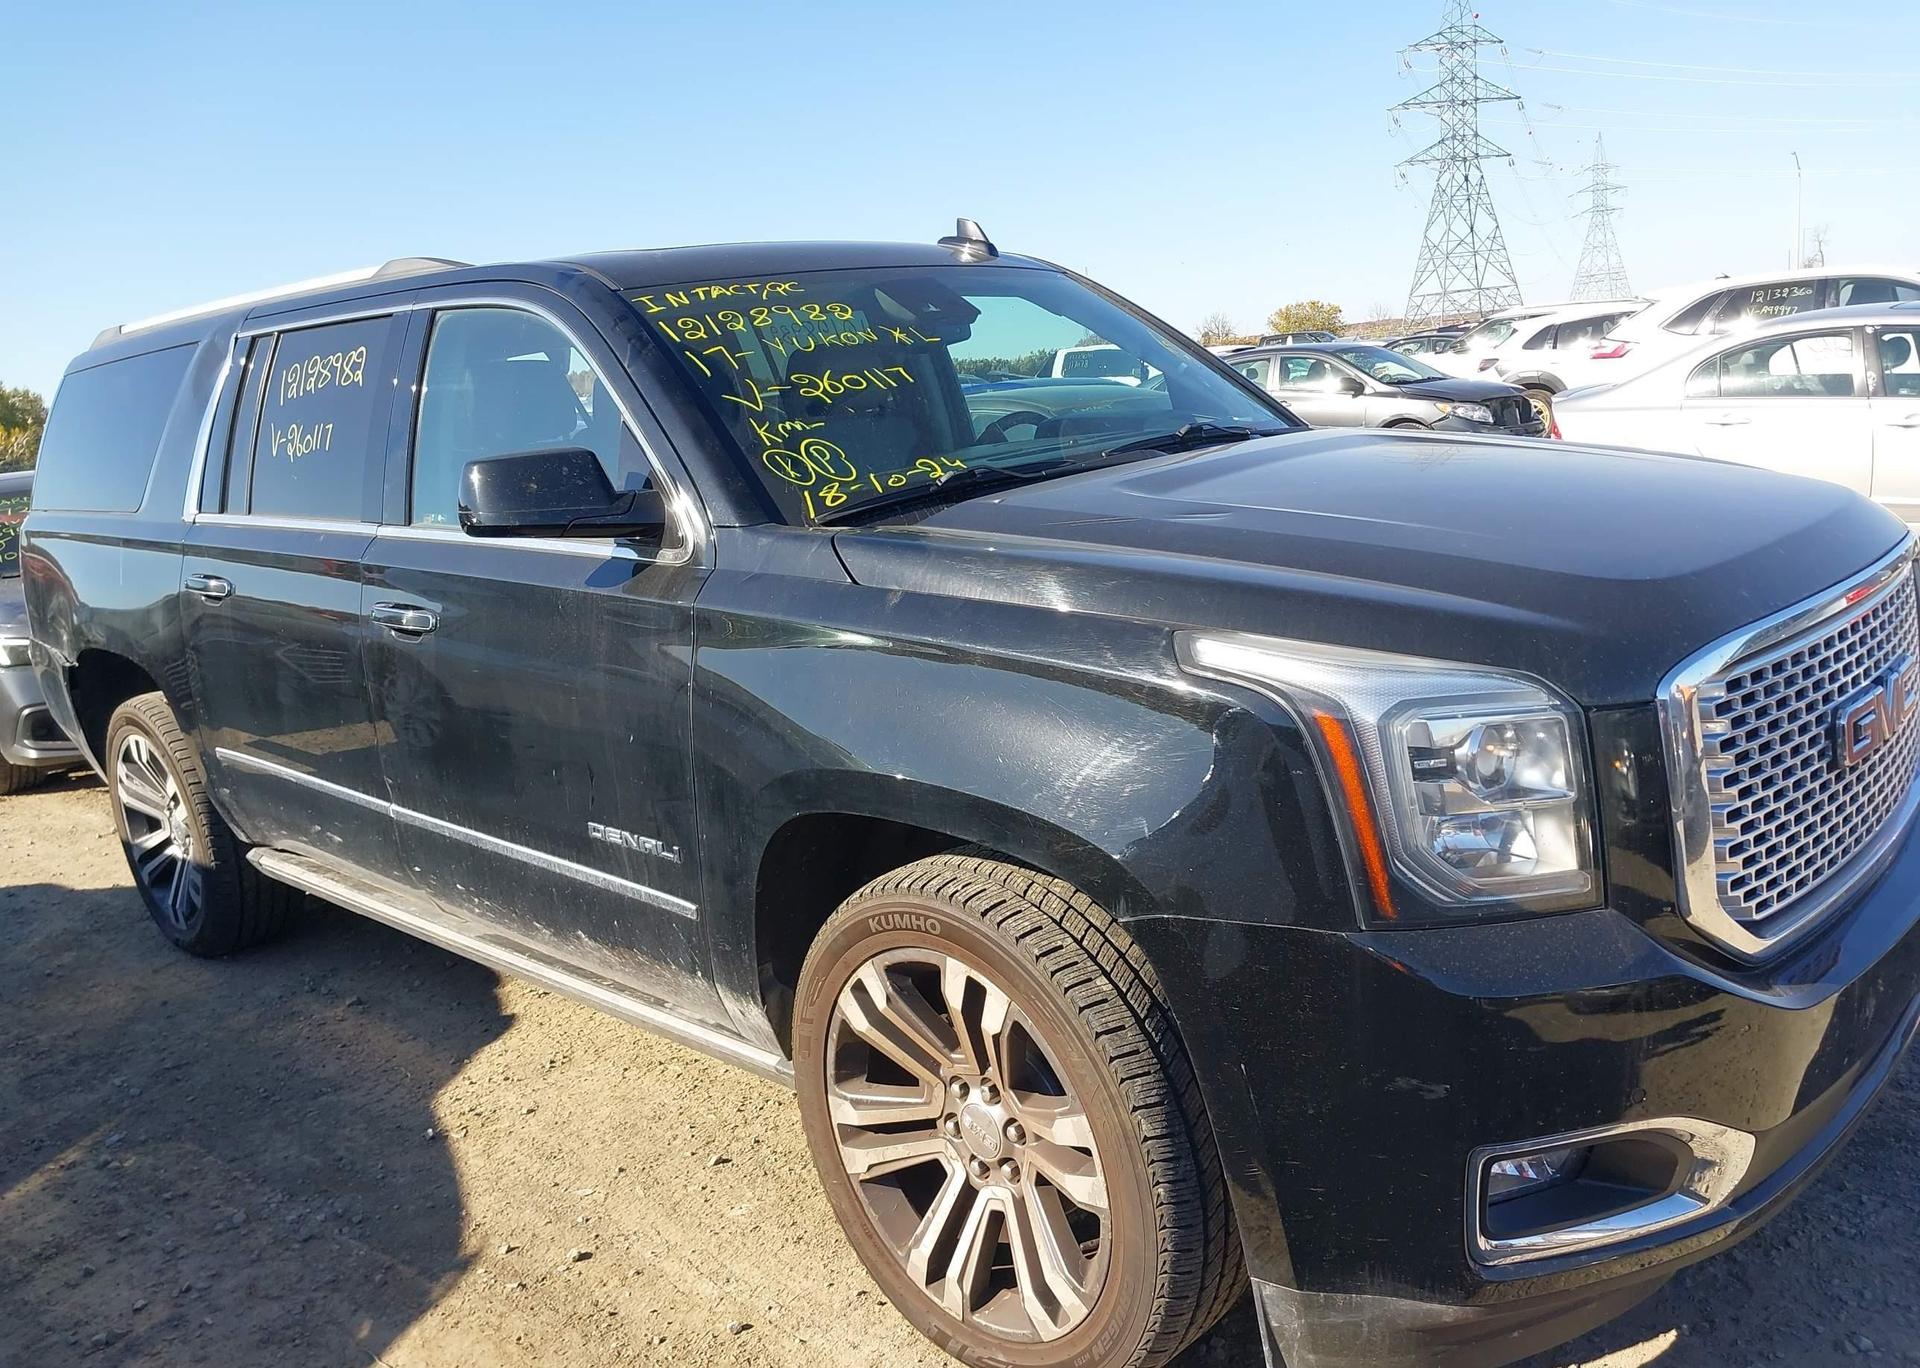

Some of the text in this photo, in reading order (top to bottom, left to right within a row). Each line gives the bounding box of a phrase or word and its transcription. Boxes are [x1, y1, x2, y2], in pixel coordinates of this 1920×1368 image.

[658, 303, 854, 343] 12128982
[762, 328, 878, 357] YUKON
[878, 325, 941, 345] XL
[280, 346, 367, 406] 12128982
[271, 423, 333, 462] V-260117
[1839, 655, 1917, 767] GMC
[588, 821, 682, 864] DENALI
[868, 913, 941, 935] KUMHO
